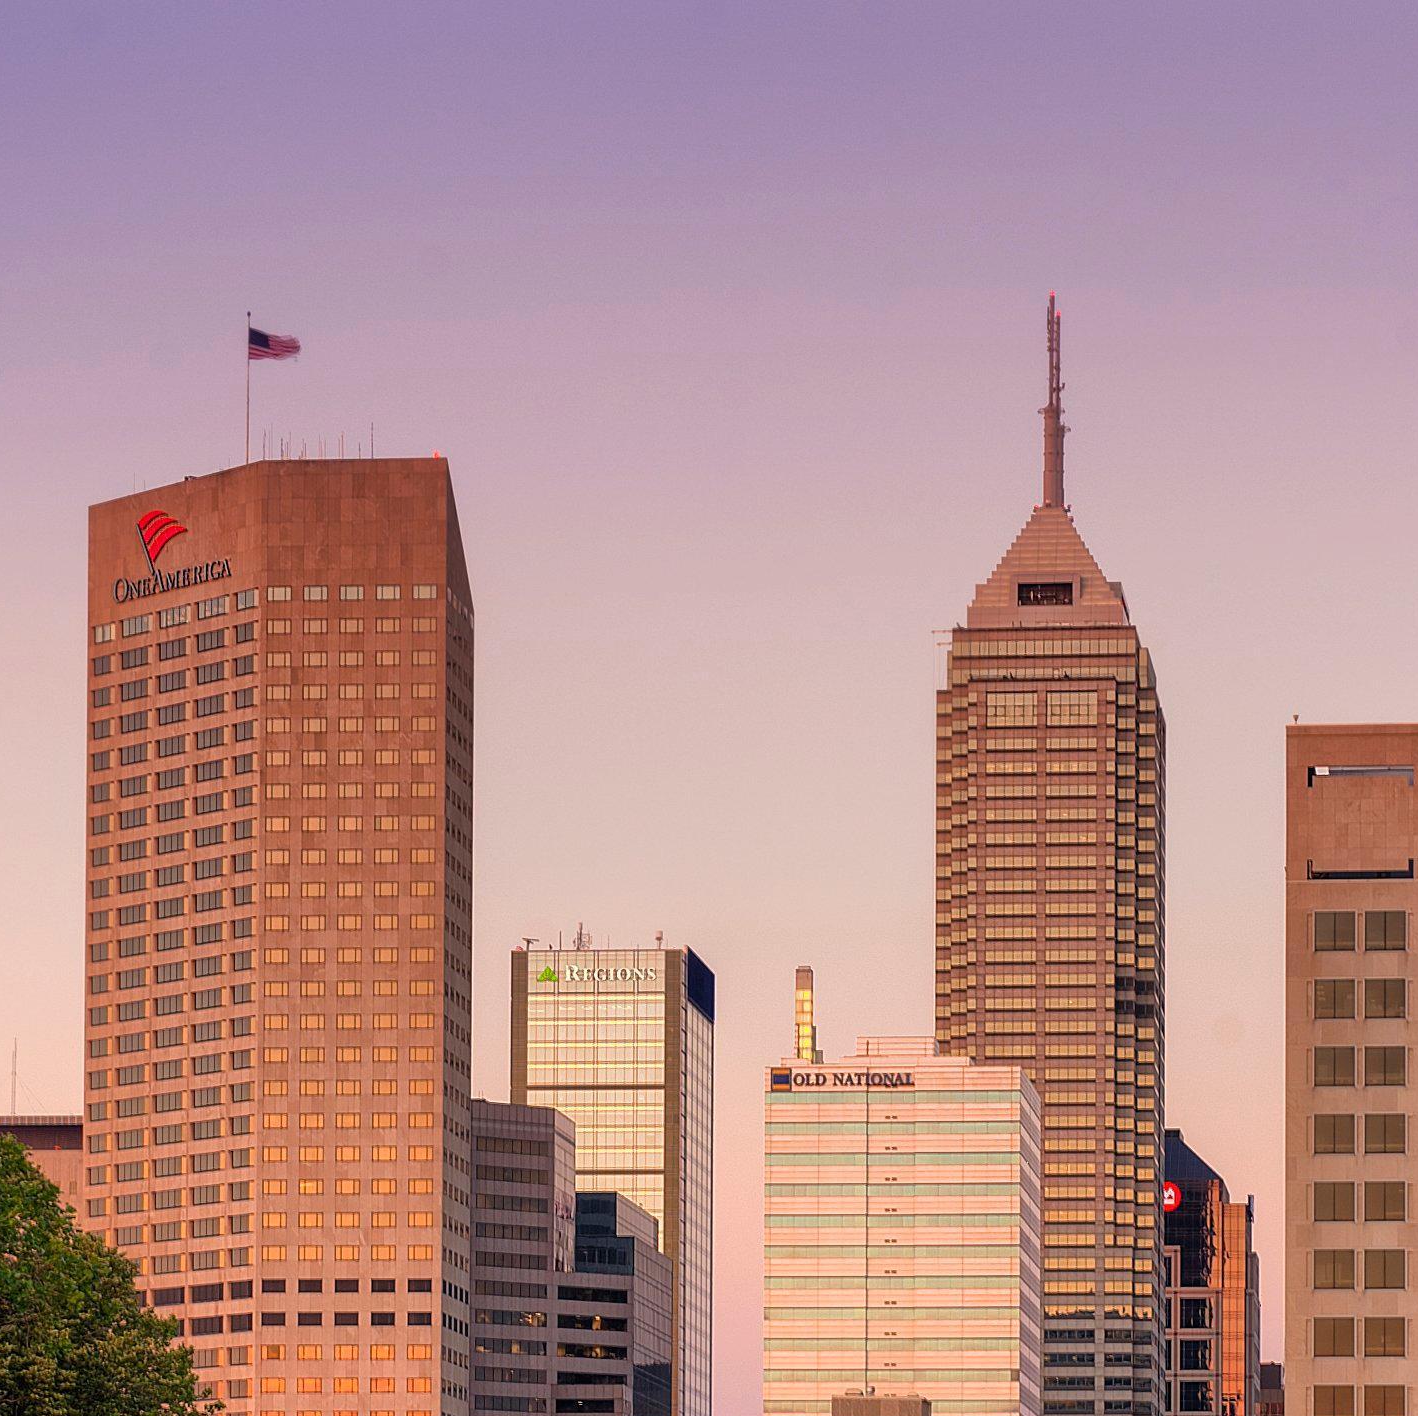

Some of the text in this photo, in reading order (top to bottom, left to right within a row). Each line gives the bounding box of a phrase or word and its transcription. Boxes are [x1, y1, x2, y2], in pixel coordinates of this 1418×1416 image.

[565, 965, 657, 982] REGIONS
[793, 1072, 915, 1088] OLD NATIONAL
